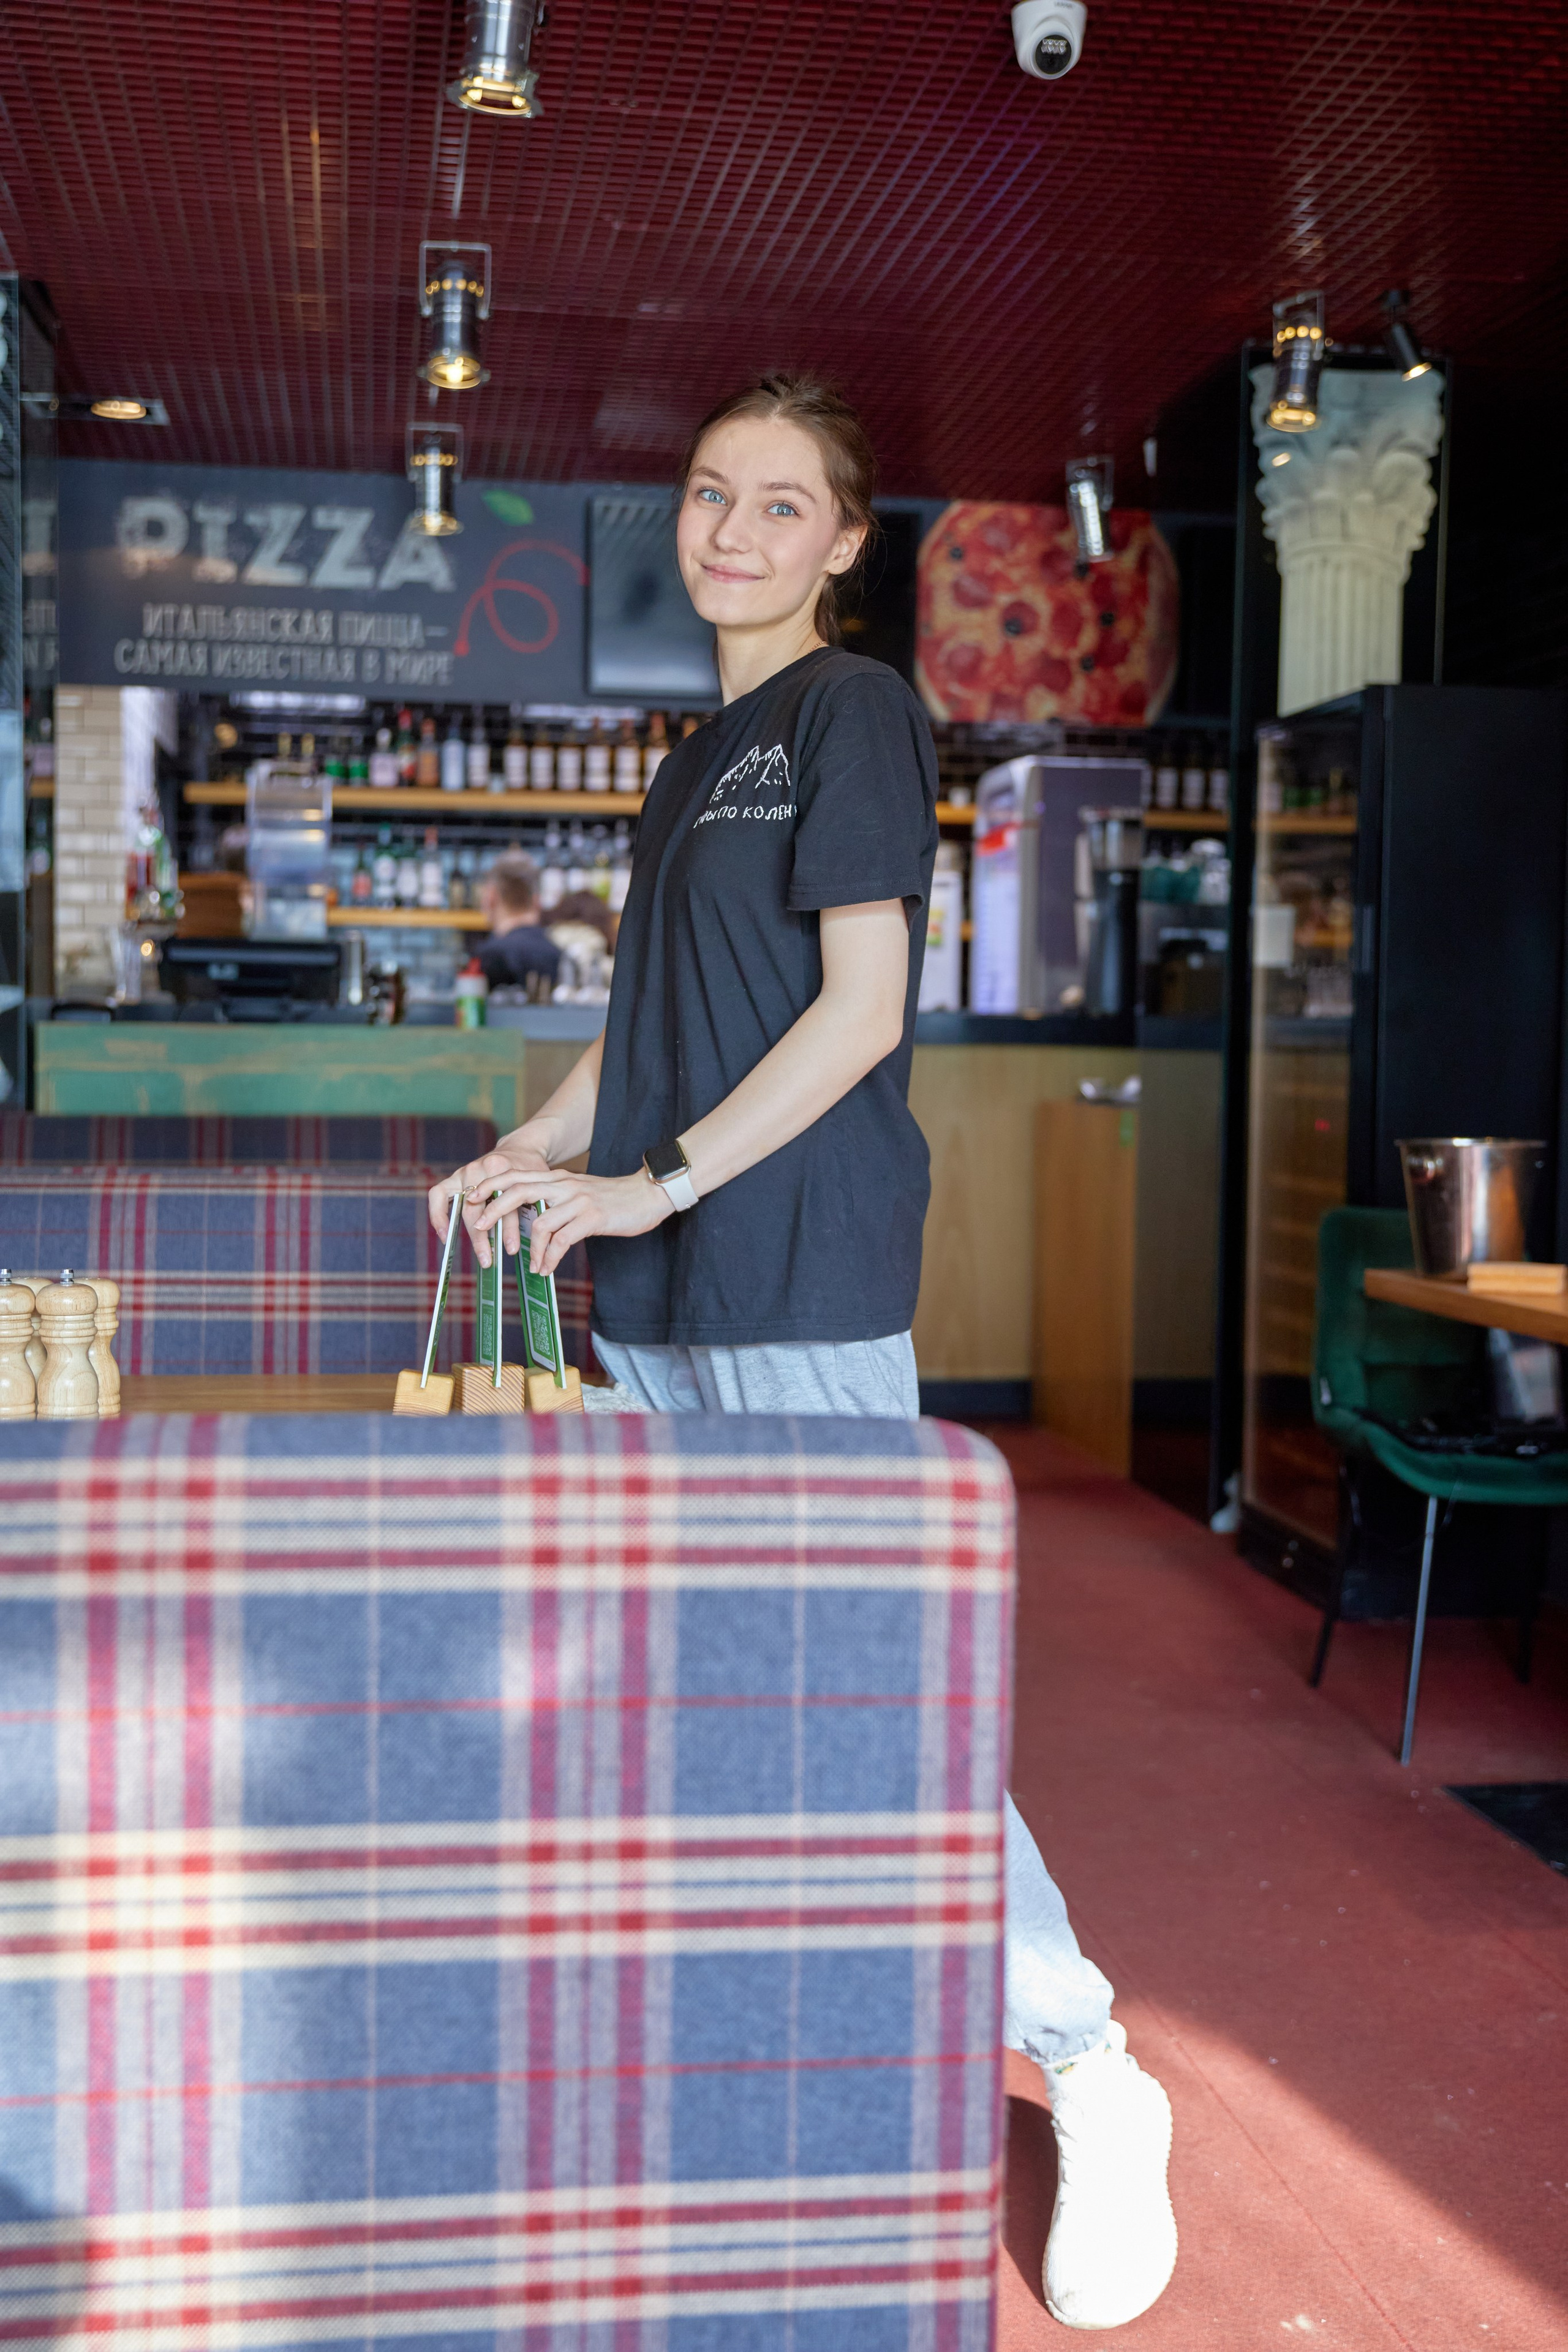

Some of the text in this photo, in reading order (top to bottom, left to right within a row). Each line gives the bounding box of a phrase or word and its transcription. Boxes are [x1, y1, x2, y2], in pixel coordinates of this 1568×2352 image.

[116, 497, 456, 592] PIZZA
[142, 602, 334, 645] ИТАЛЬЯНСКАЯ
[113, 638, 454, 685] САМАЯ ИЗВЕСТНАЯ В МИРЕ
